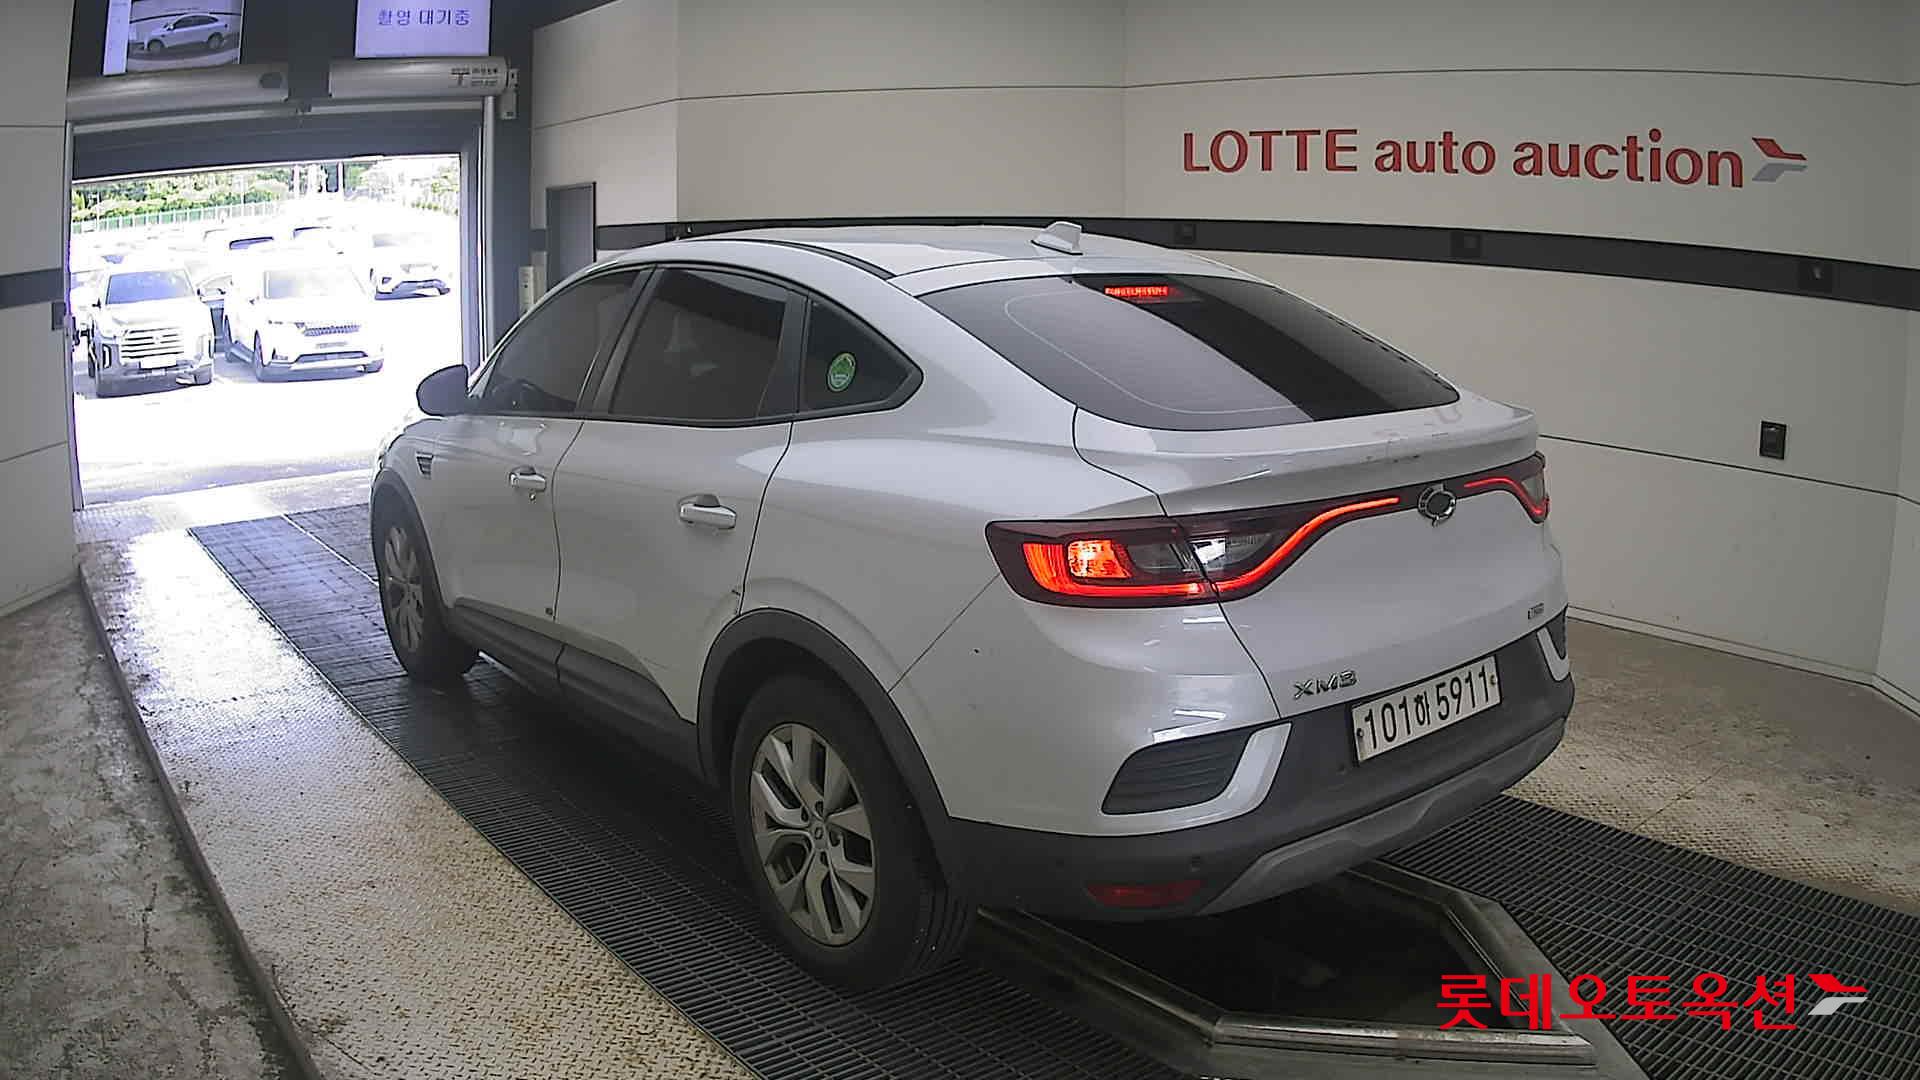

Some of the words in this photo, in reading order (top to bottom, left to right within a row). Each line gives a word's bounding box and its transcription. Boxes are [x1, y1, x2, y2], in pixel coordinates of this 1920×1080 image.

[419, 9, 470, 26] 대기중
[1183, 129, 1358, 173] LOTTE
[1374, 131, 1497, 175] auto
[1512, 128, 1744, 188] auction
[1294, 670, 1357, 700] XM3
[1436, 665, 1490, 721] 5911
